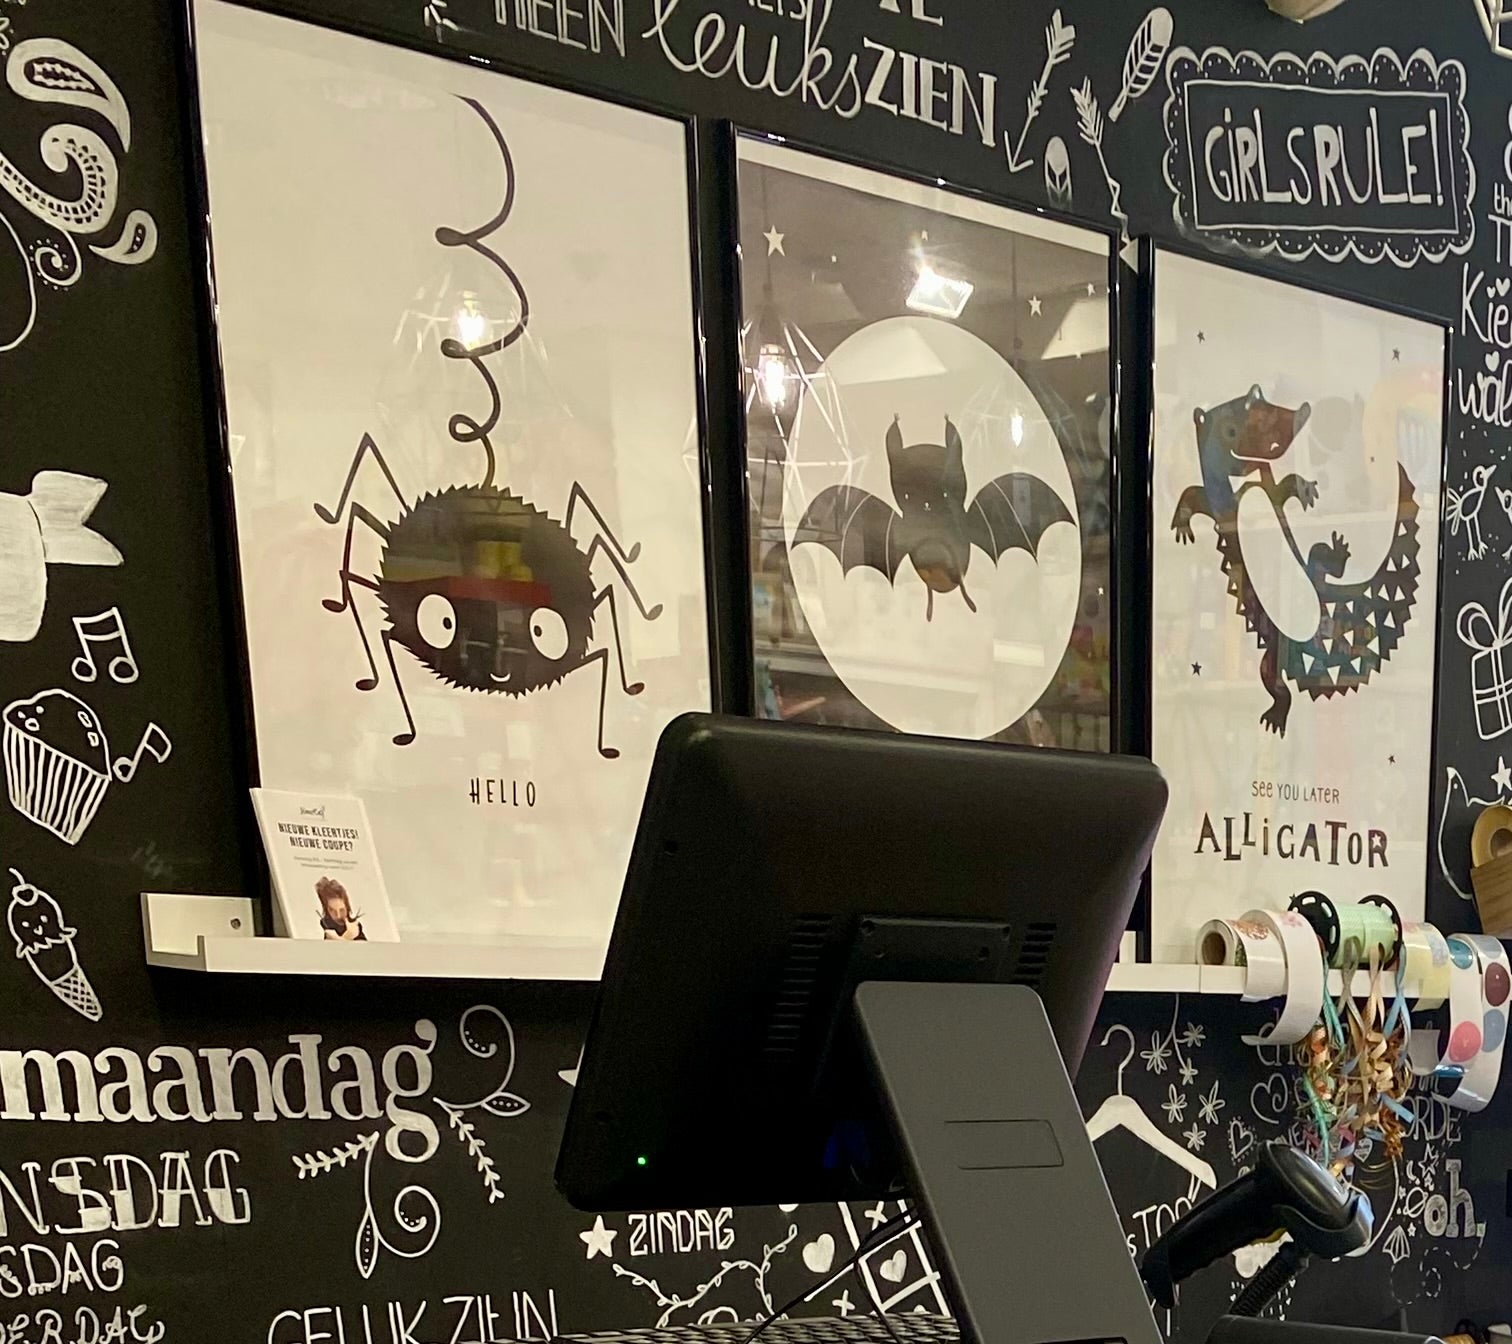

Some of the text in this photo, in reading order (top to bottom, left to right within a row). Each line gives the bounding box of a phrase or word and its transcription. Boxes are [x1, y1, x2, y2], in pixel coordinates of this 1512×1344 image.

[863, 36, 998, 148] ZIEN
[1312, 106, 1445, 207] RULE!
[468, 777, 536, 808] HELLO
[1277, 783, 1301, 801] YOU
[277, 822, 360, 840] NIEUWE KLEERTJES!
[289, 836, 354, 852] NIEUWE COUPE?
[0, 1018, 440, 1163] maandag
